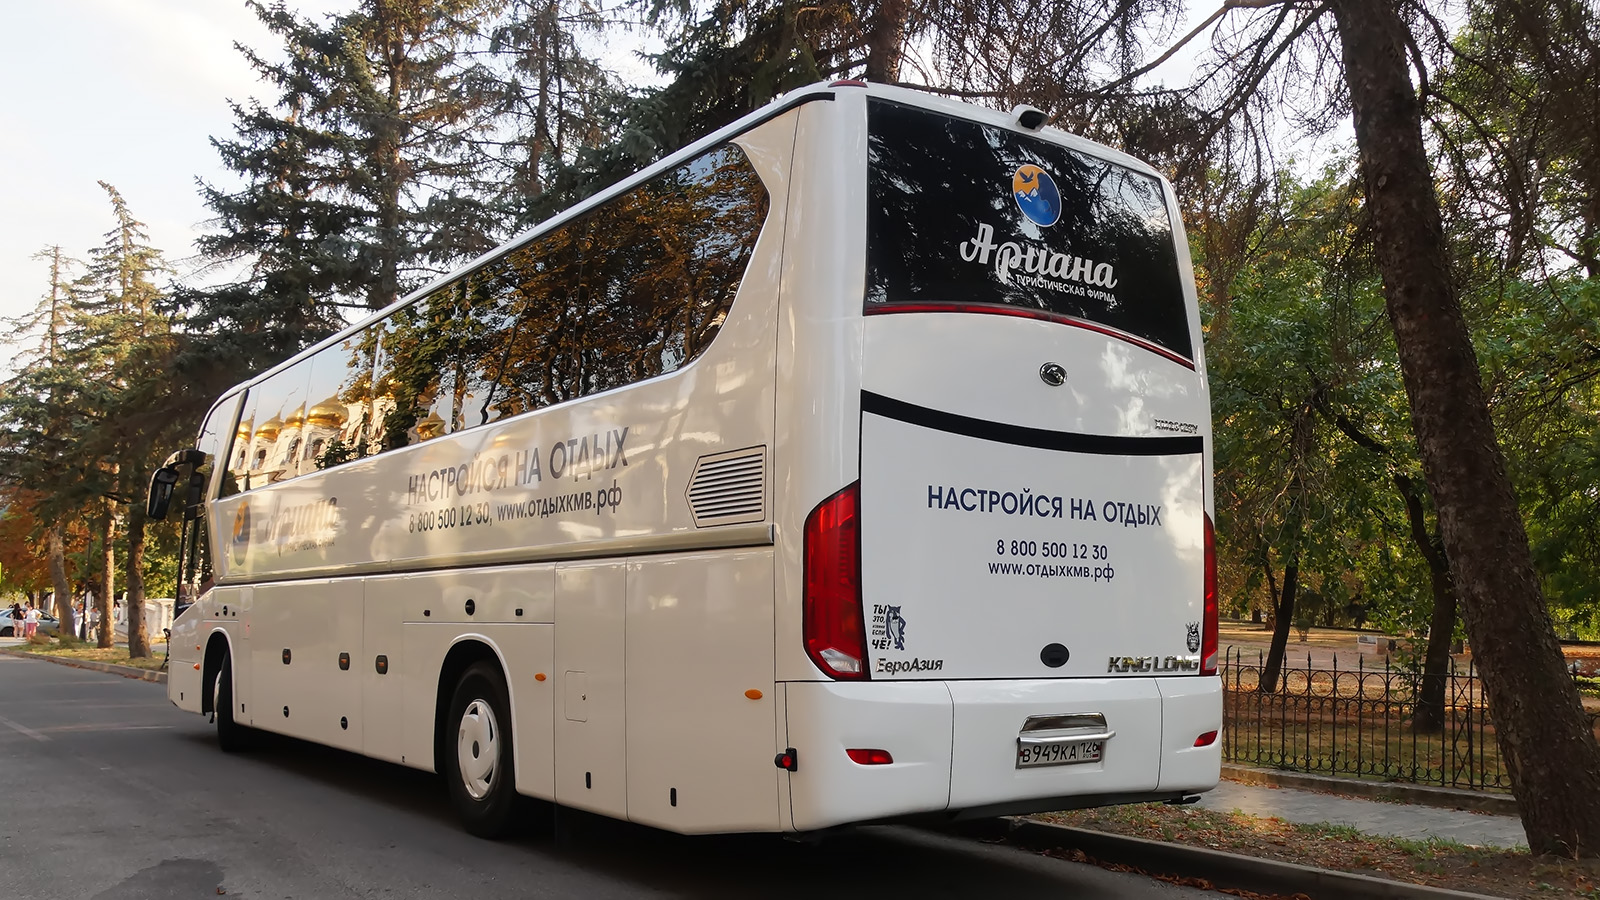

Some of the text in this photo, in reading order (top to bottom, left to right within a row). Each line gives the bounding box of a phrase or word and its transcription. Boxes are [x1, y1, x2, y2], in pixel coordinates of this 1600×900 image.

[960, 223, 1118, 289] Ариана
[1015, 274, 1117, 304] ТУРИСТИЧЕСКАЯ ФИРМА
[408, 427, 629, 506] НАСТРОЙСЯ НА ОТДЫХ
[409, 514, 415, 533] 8
[417, 509, 435, 533] 800
[438, 507, 457, 530] 500
[459, 503, 473, 527] 12
[927, 485, 1162, 528] НАСТРОЙСЯ НА ОТДЫХ
[996, 539, 1108, 560] 8 800 500 12 30
[873, 604, 887, 614] ТЫ
[872, 637, 892, 650] ЧЁ!
[1107, 655, 1199, 673] KING LONG
[1080, 741, 1099, 753] 126
